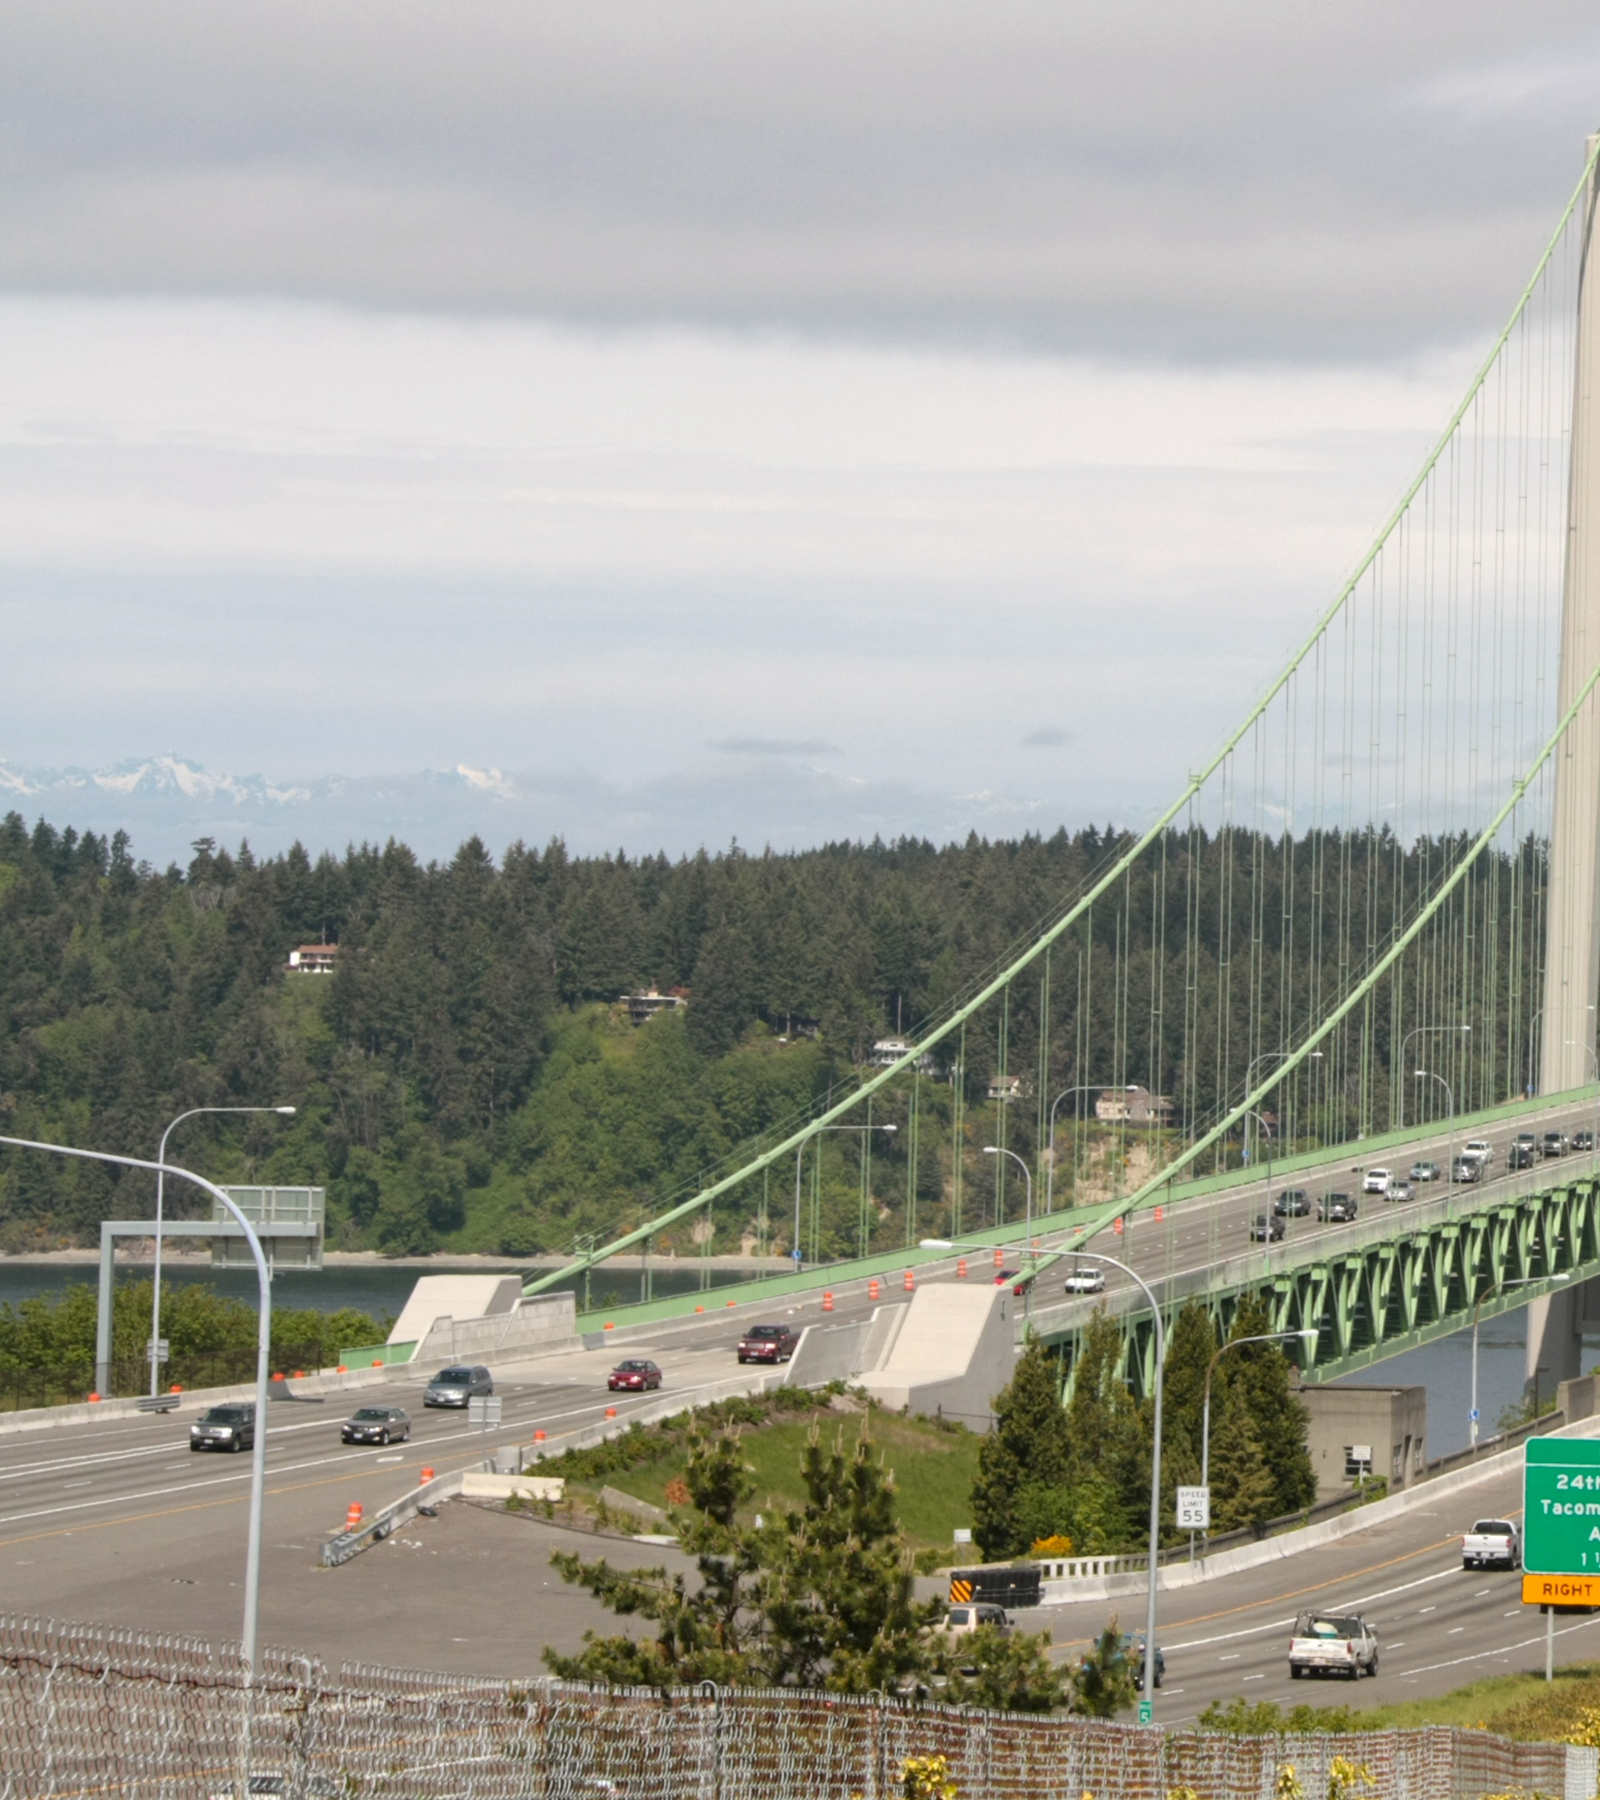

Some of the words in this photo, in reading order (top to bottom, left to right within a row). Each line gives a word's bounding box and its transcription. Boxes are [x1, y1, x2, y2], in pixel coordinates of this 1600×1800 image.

[1180, 1490, 1206, 1498] SPEED
[1183, 1510, 1203, 1522] 55
[1580, 1552, 1588, 1567] 1
[1542, 1583, 1593, 1597] RIGHT
